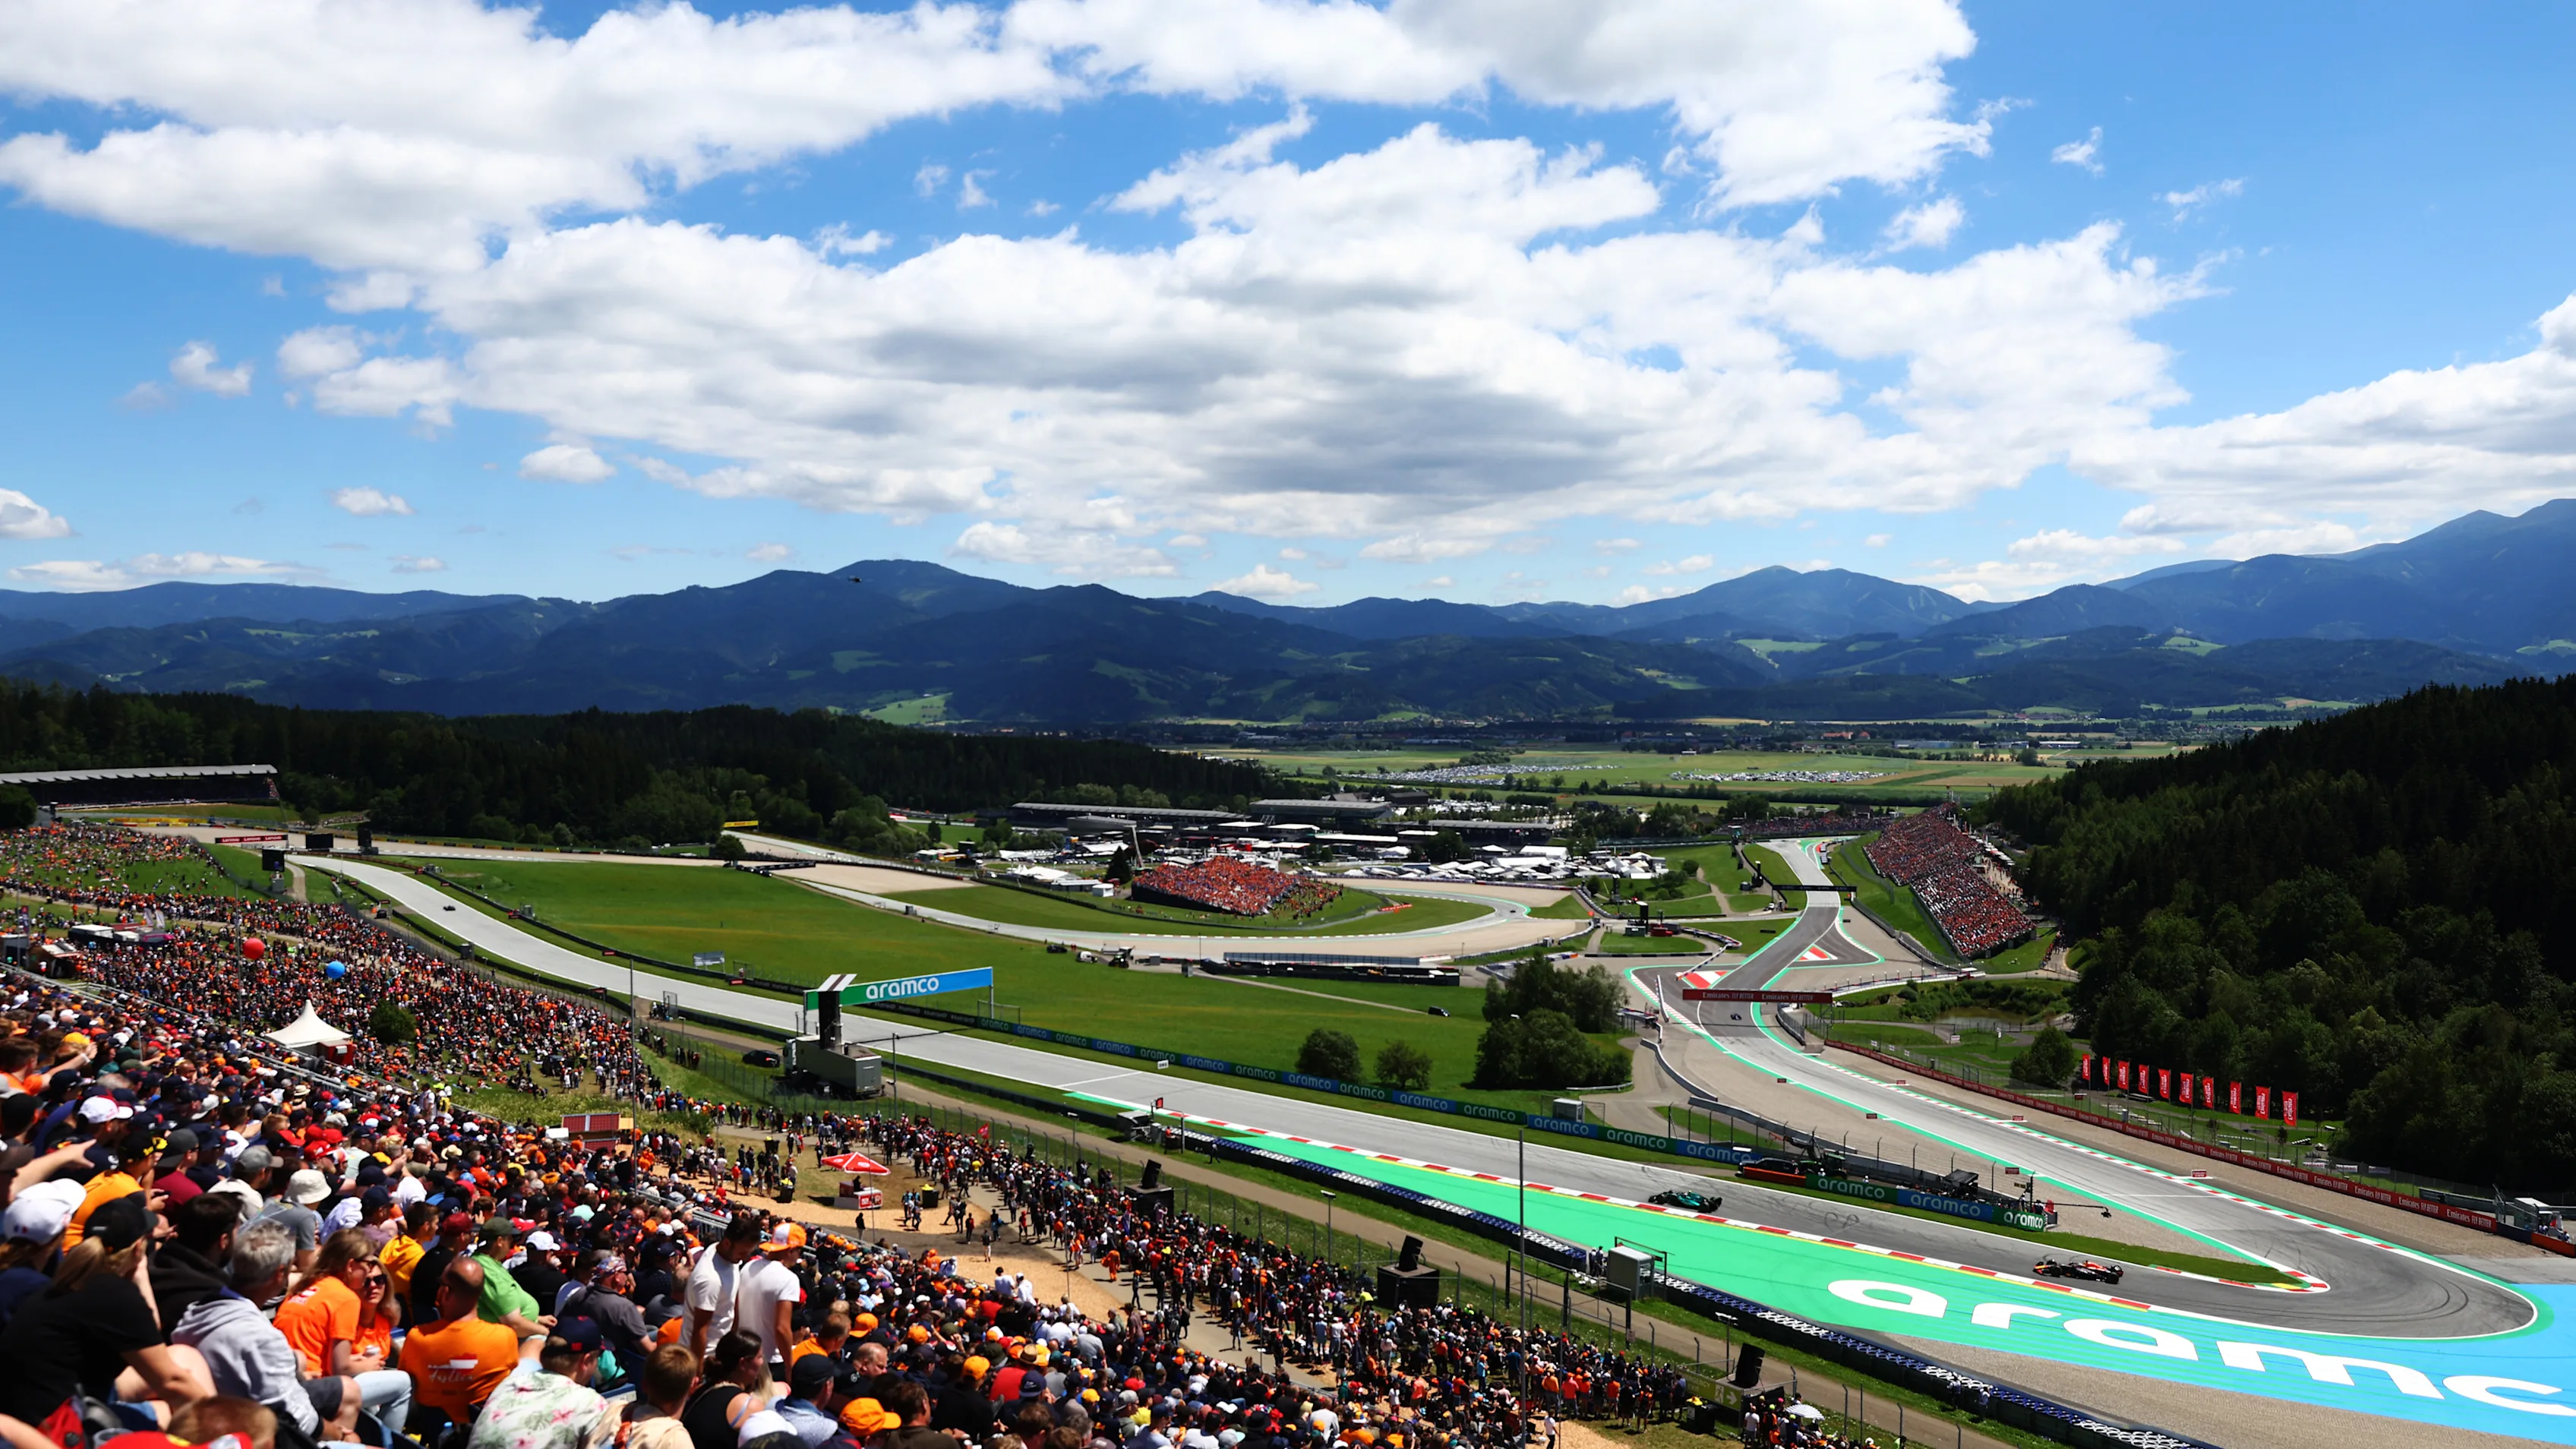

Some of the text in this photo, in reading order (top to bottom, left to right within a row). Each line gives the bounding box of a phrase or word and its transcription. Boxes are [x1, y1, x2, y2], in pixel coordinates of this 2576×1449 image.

[866, 977, 939, 999] aramco
[981, 1018, 1009, 1031] aramco
[1018, 1024, 1046, 1039] aramco
[1056, 1032, 1087, 1046] aramco
[1097, 1040, 1130, 1055] aramco
[1141, 1048, 1176, 1062] aramco
[1186, 1056, 1224, 1071] aramco
[1236, 1065, 1276, 1080] aramco
[1288, 1074, 1331, 1090] aramco
[1340, 1083, 1385, 1100] aramco
[1400, 1094, 1447, 1111] aramco
[1464, 1104, 1516, 1122] aramco
[1534, 1116, 1589, 1135] aramco
[1607, 1129, 1666, 1150] aramco
[1687, 1144, 1753, 1163] aramco
[2277, 1166, 2293, 1176] Emirates
[1818, 1178, 1885, 1198] aramco
[2314, 1176, 2332, 1187] Emirates
[2354, 1185, 2374, 1198] Emirates
[1911, 1194, 1981, 1217] aramco
[2398, 1197, 2420, 1211] Emirates
[2426, 1204, 2439, 1214] BETTER
[2003, 1211, 2043, 1229] aramco
[2447, 1209, 2470, 1223] Emirates
[2478, 1217, 2492, 1228] BETTER
[1827, 1280, 2576, 1416] aramc
